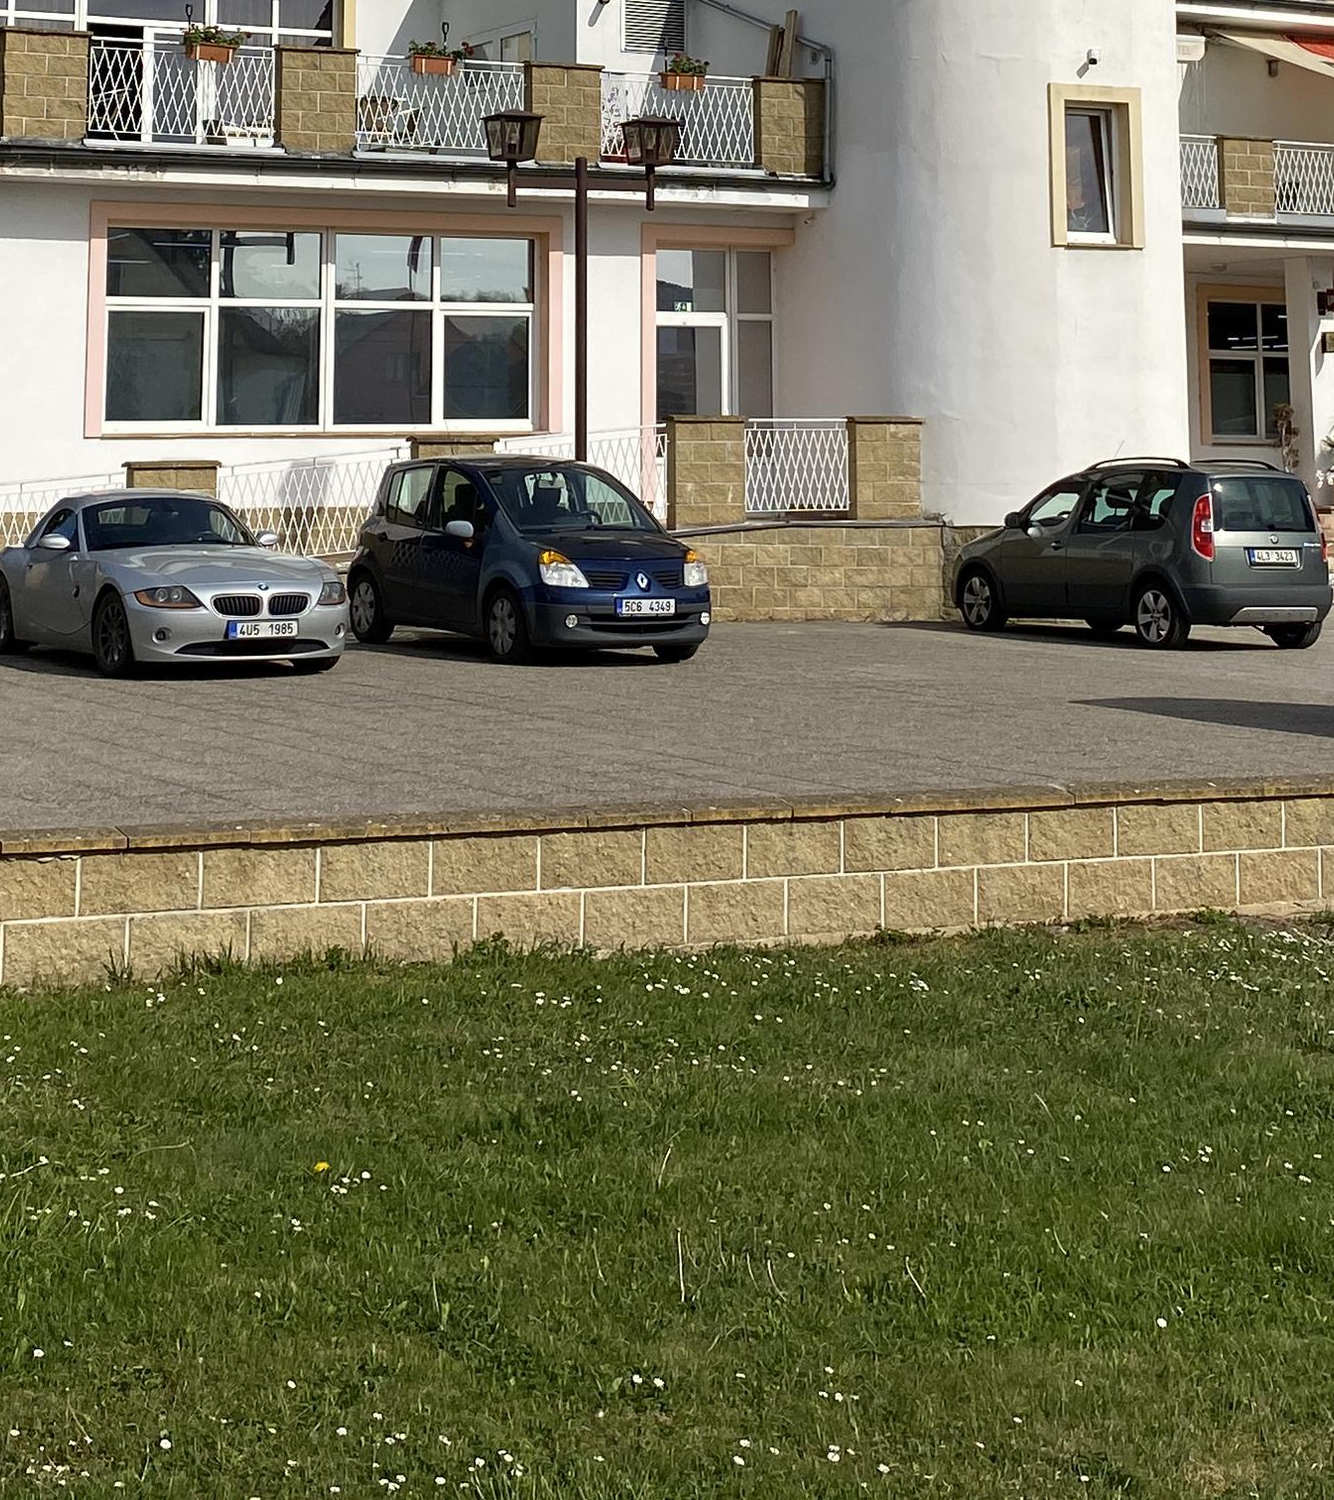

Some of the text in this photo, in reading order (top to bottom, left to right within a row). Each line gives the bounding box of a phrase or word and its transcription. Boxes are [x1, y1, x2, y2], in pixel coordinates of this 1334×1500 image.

[1275, 551, 1294, 561] 3423
[649, 601, 671, 612] 4349
[239, 622, 294, 636] 4U5 1985
